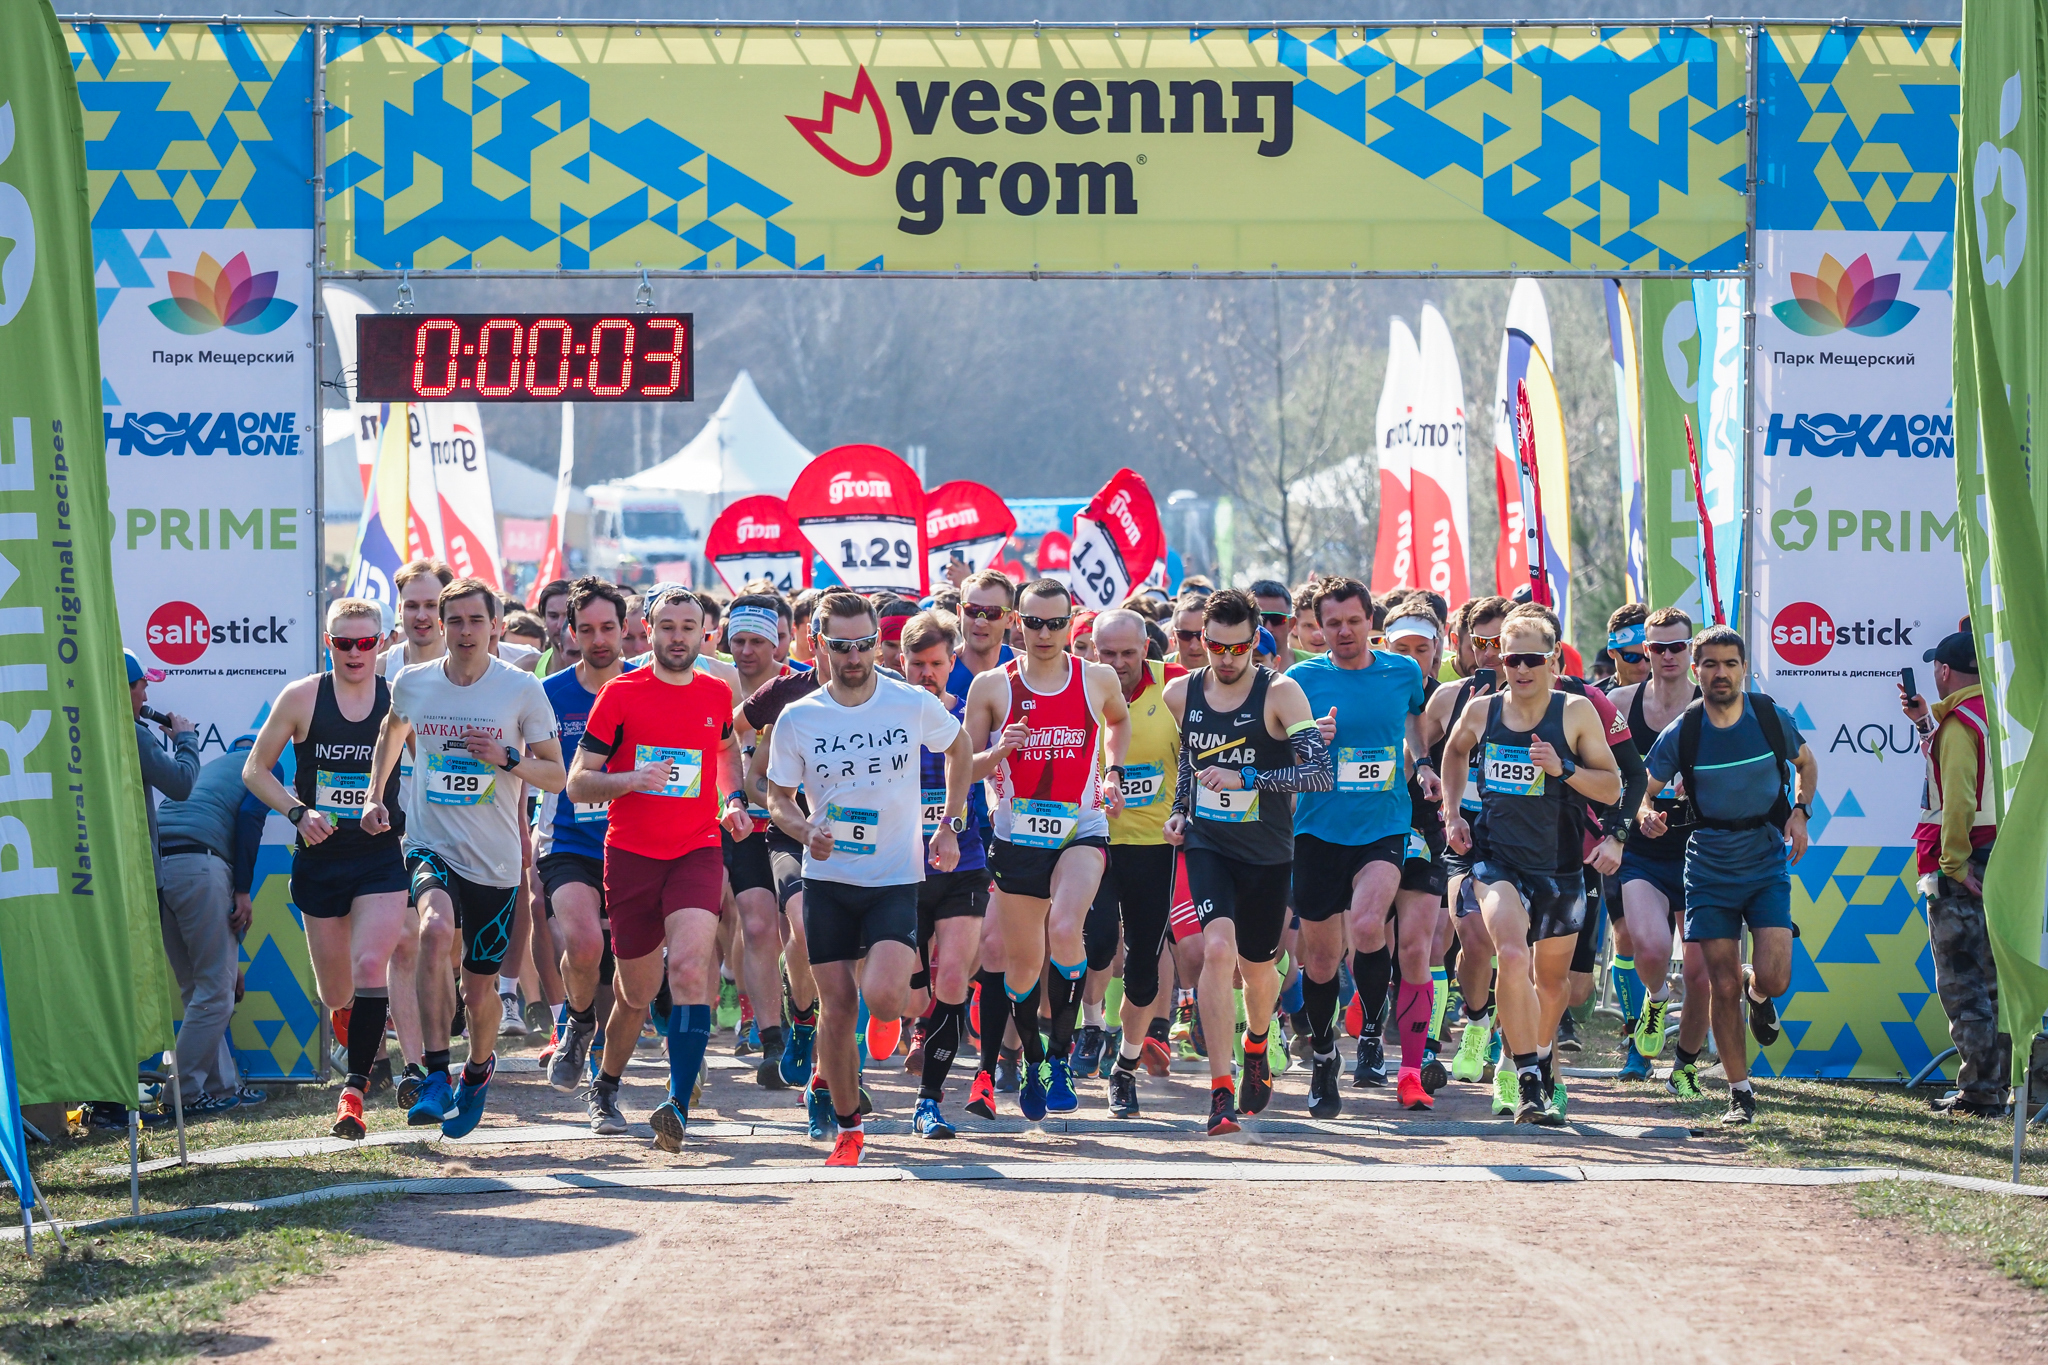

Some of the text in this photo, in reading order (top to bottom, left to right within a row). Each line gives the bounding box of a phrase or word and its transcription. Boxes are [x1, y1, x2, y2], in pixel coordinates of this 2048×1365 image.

[895, 156, 1138, 235] grom
[152, 350, 295, 366] Парк Мещерский
[411, 319, 685, 396] 0:00:03
[1774, 351, 1915, 368] Парк Мещерский
[103, 411, 296, 457] HOKA ONE
[1764, 412, 1954, 458] HOKA ON
[242, 434, 300, 457] ONE
[1911, 437, 1955, 458] ON
[829, 475, 893, 504] grom
[127, 508, 297, 551] PRIME
[1106, 492, 1141, 547] grom
[1828, 510, 1962, 553] PRIM
[841, 537, 913, 569] 1.29
[1072, 541, 1115, 606] 1.29
[149, 616, 288, 644] saltstick
[1773, 616, 1913, 645] saltstick
[49, 418, 94, 896] Natural food Original recipes
[226, 669, 287, 677] ДИСПЕНСЕРЫ
[1775, 669, 1841, 677] ЭЛЕКТРОЛИТЫ
[1850, 670, 1902, 678] ДИСПЕНСЕР
[1189, 709, 1203, 723] AG
[1053, 729, 1085, 746] Class
[1188, 732, 1227, 749] RUN
[1024, 749, 1076, 761] RUSSIA
[1217, 748, 1256, 764] LAB
[816, 753, 909, 779] CREW
[1358, 764, 1380, 779] 26
[1492, 762, 1535, 781] 1293
[442, 774, 479, 792] 129
[1120, 779, 1152, 795] 520
[331, 789, 366, 805] 496
[1220, 793, 1231, 808] 5
[853, 825, 865, 840] 6
[1027, 817, 1061, 834] 130
[1197, 899, 1214, 920] AG
